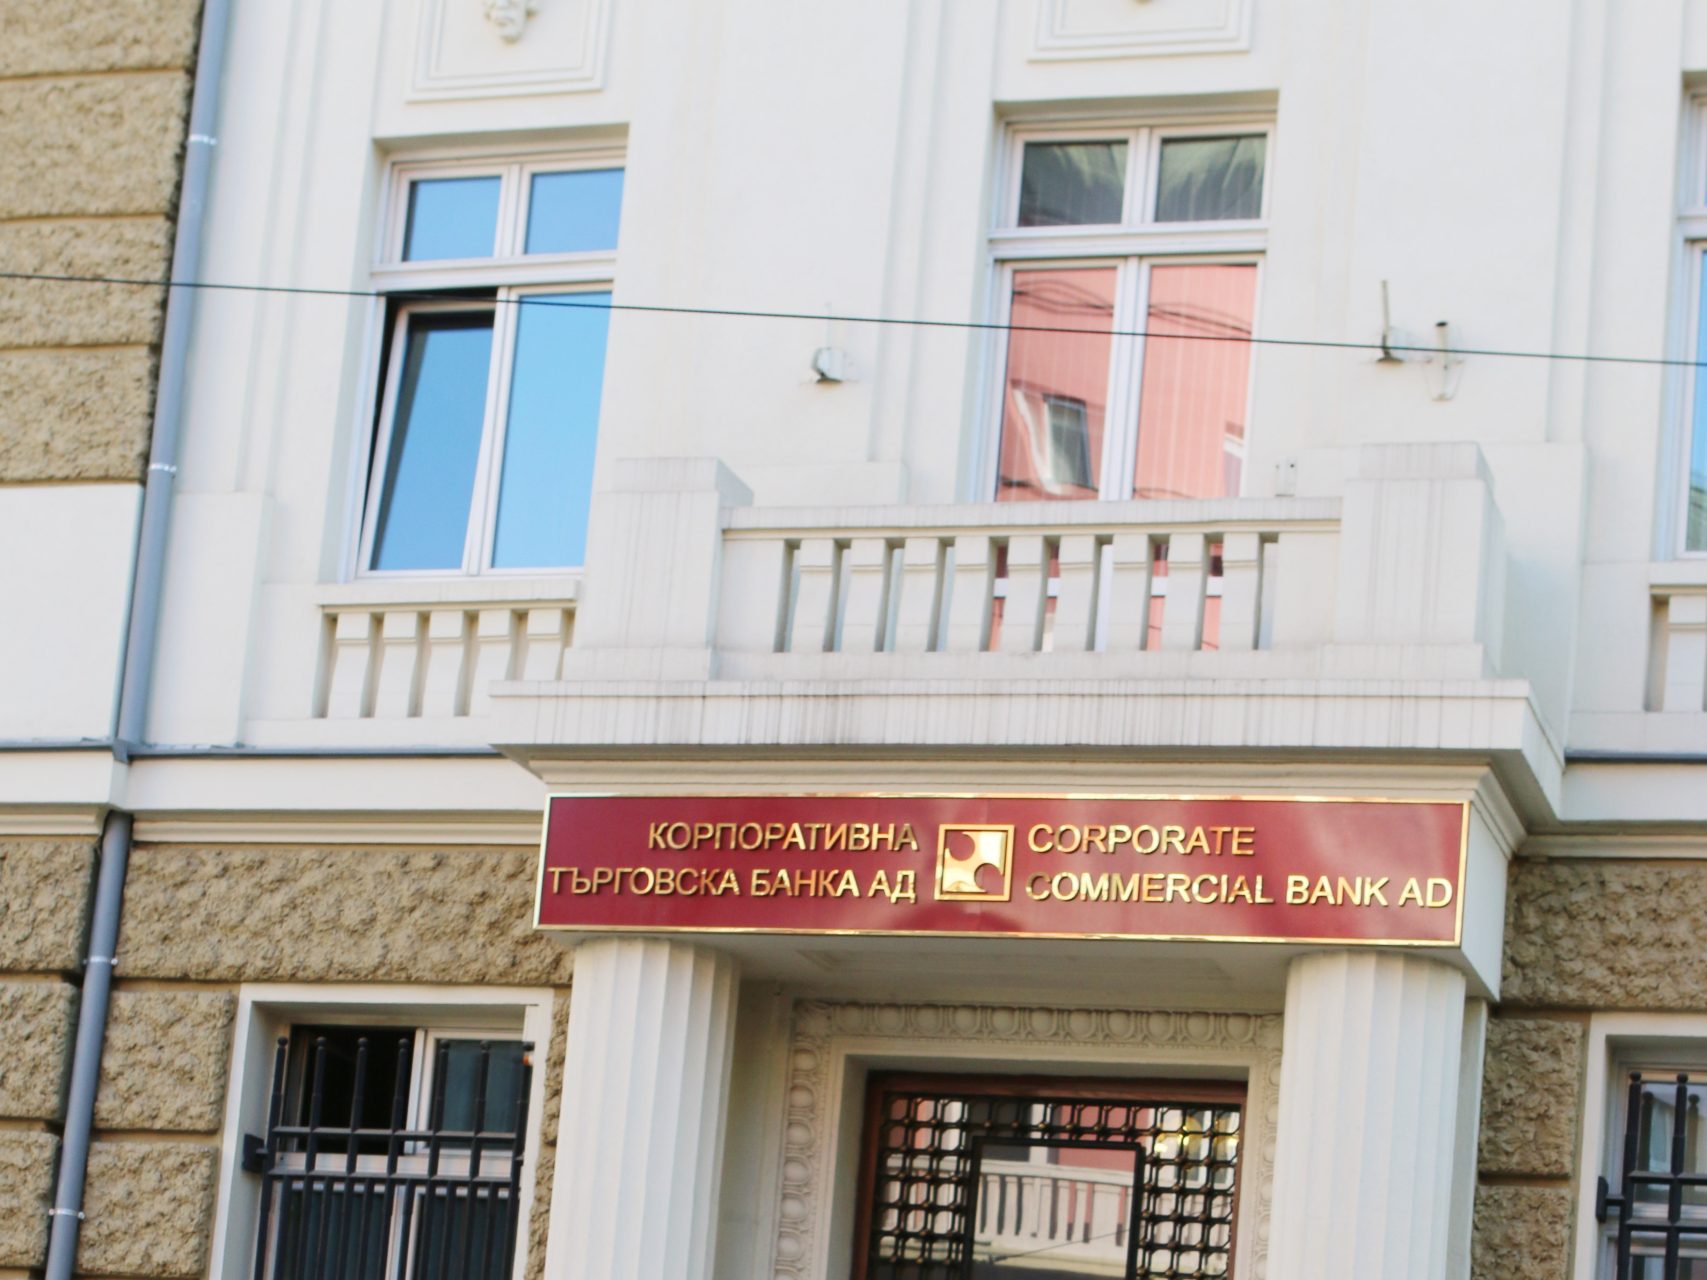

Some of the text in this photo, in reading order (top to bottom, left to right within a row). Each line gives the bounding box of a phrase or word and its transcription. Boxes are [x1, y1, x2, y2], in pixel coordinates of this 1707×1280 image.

[648, 822, 919, 851] КОРПОРАТИВНА
[1027, 824, 1256, 856] CORPORATE
[547, 866, 917, 904] ТЪРГОВСКА БАНКА АД
[1025, 871, 1454, 908] COMMERCIAL BANK AD
